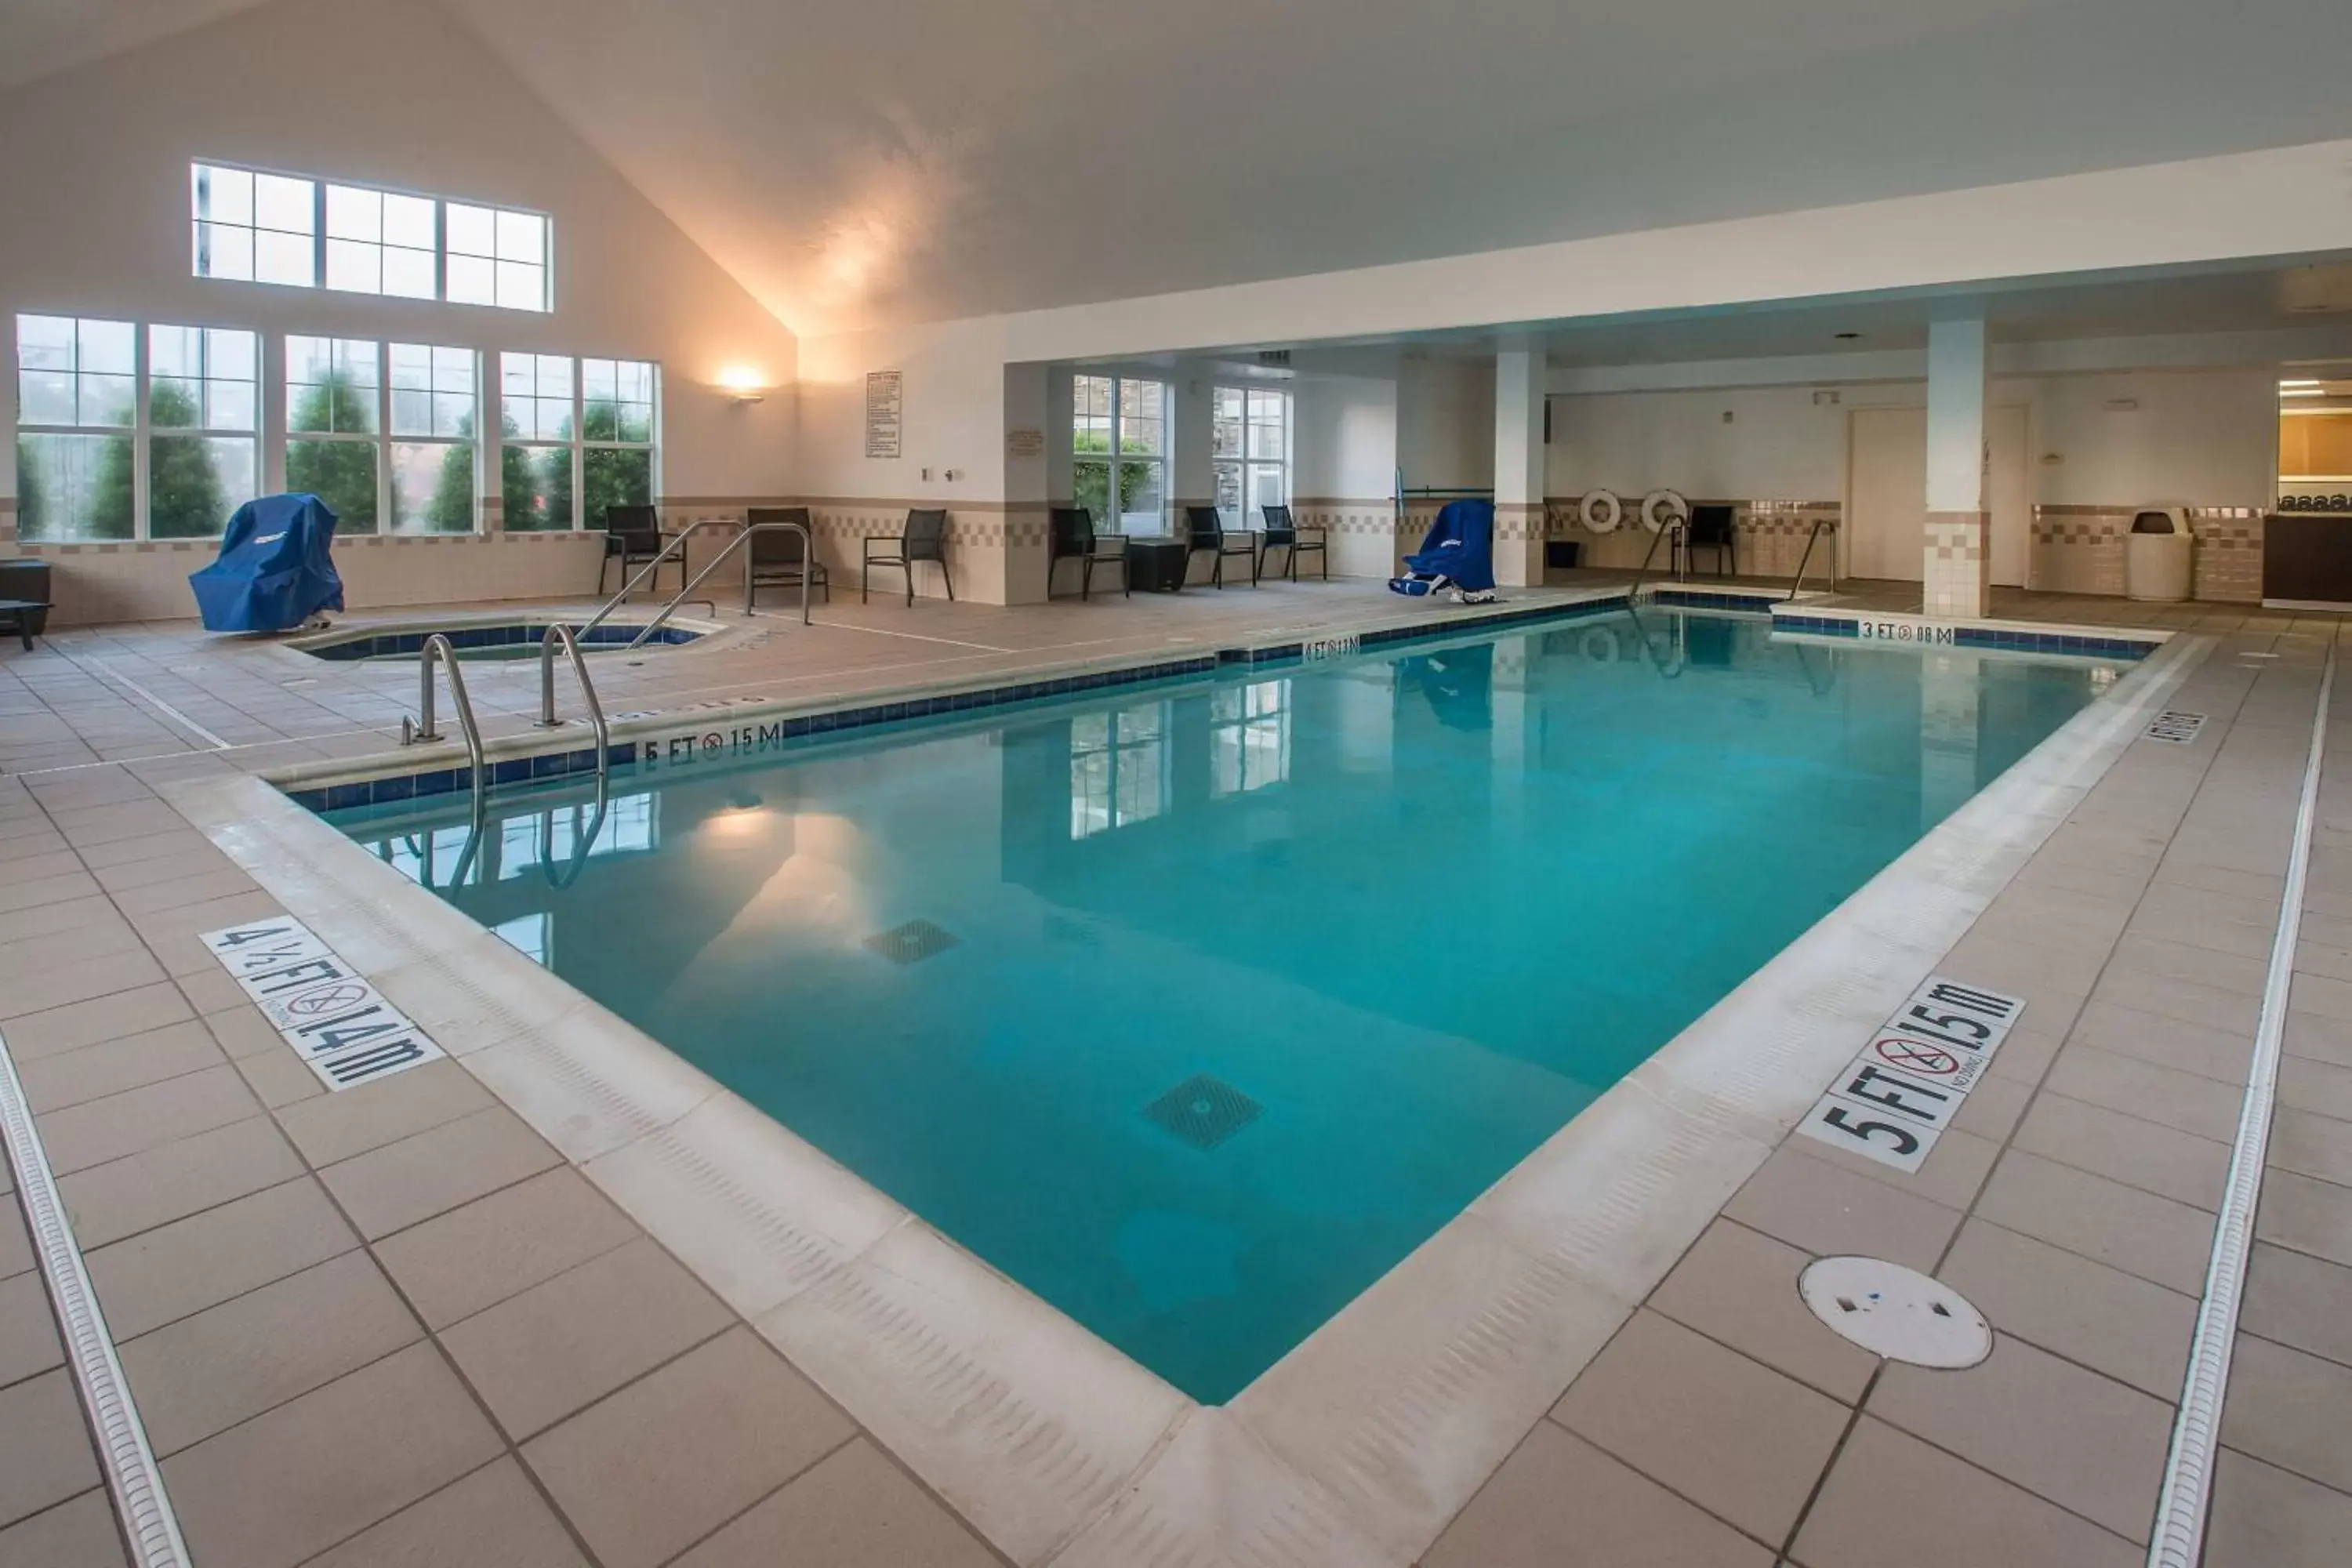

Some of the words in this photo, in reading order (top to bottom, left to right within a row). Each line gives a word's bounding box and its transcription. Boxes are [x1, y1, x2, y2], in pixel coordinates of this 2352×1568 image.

[669, 735, 697, 757] FT
[759, 722, 780, 744] M
[217, 927, 292, 947] 4
[250, 959, 343, 995] FT
[1846, 1065, 1948, 1121] FT
[1822, 1105, 1918, 1155] 5
